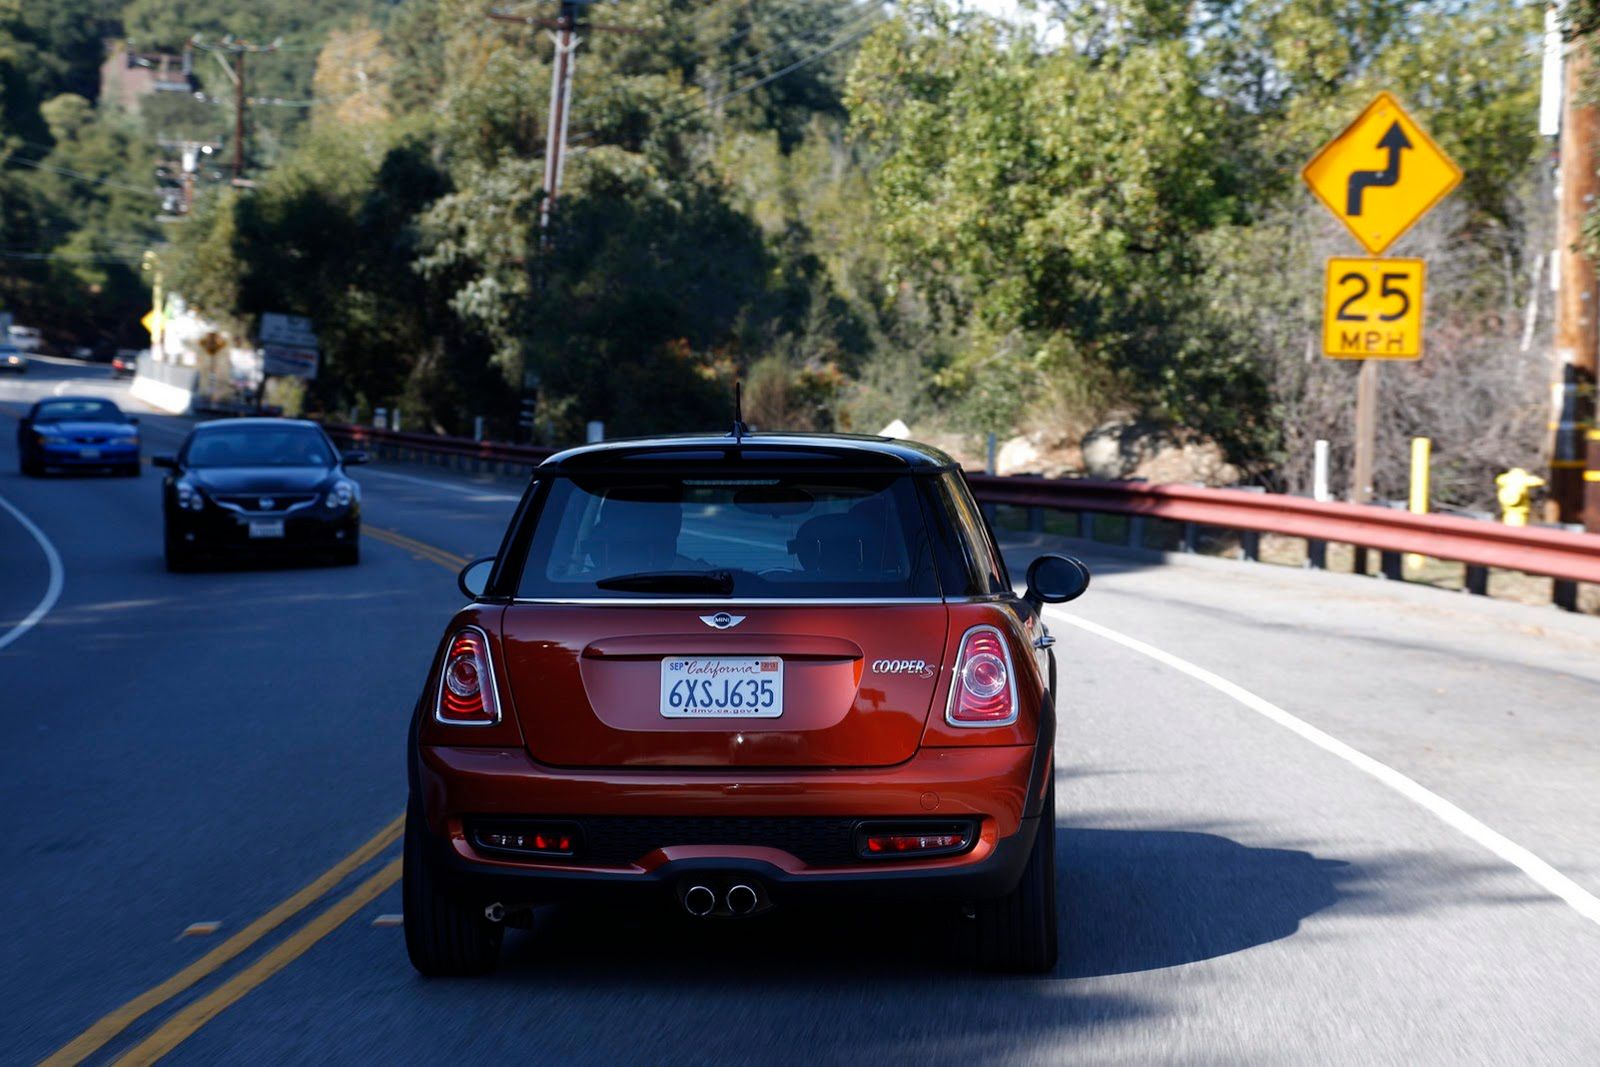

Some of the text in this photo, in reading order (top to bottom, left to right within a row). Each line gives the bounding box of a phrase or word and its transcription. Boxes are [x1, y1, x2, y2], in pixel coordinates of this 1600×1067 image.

[1336, 272, 1410, 321] 25
[1340, 331, 1404, 351] MPH
[669, 662, 684, 671] SEP
[687, 660, 761, 678] California
[872, 659, 925, 674] COOPER
[668, 679, 774, 708] 6XSJ635
